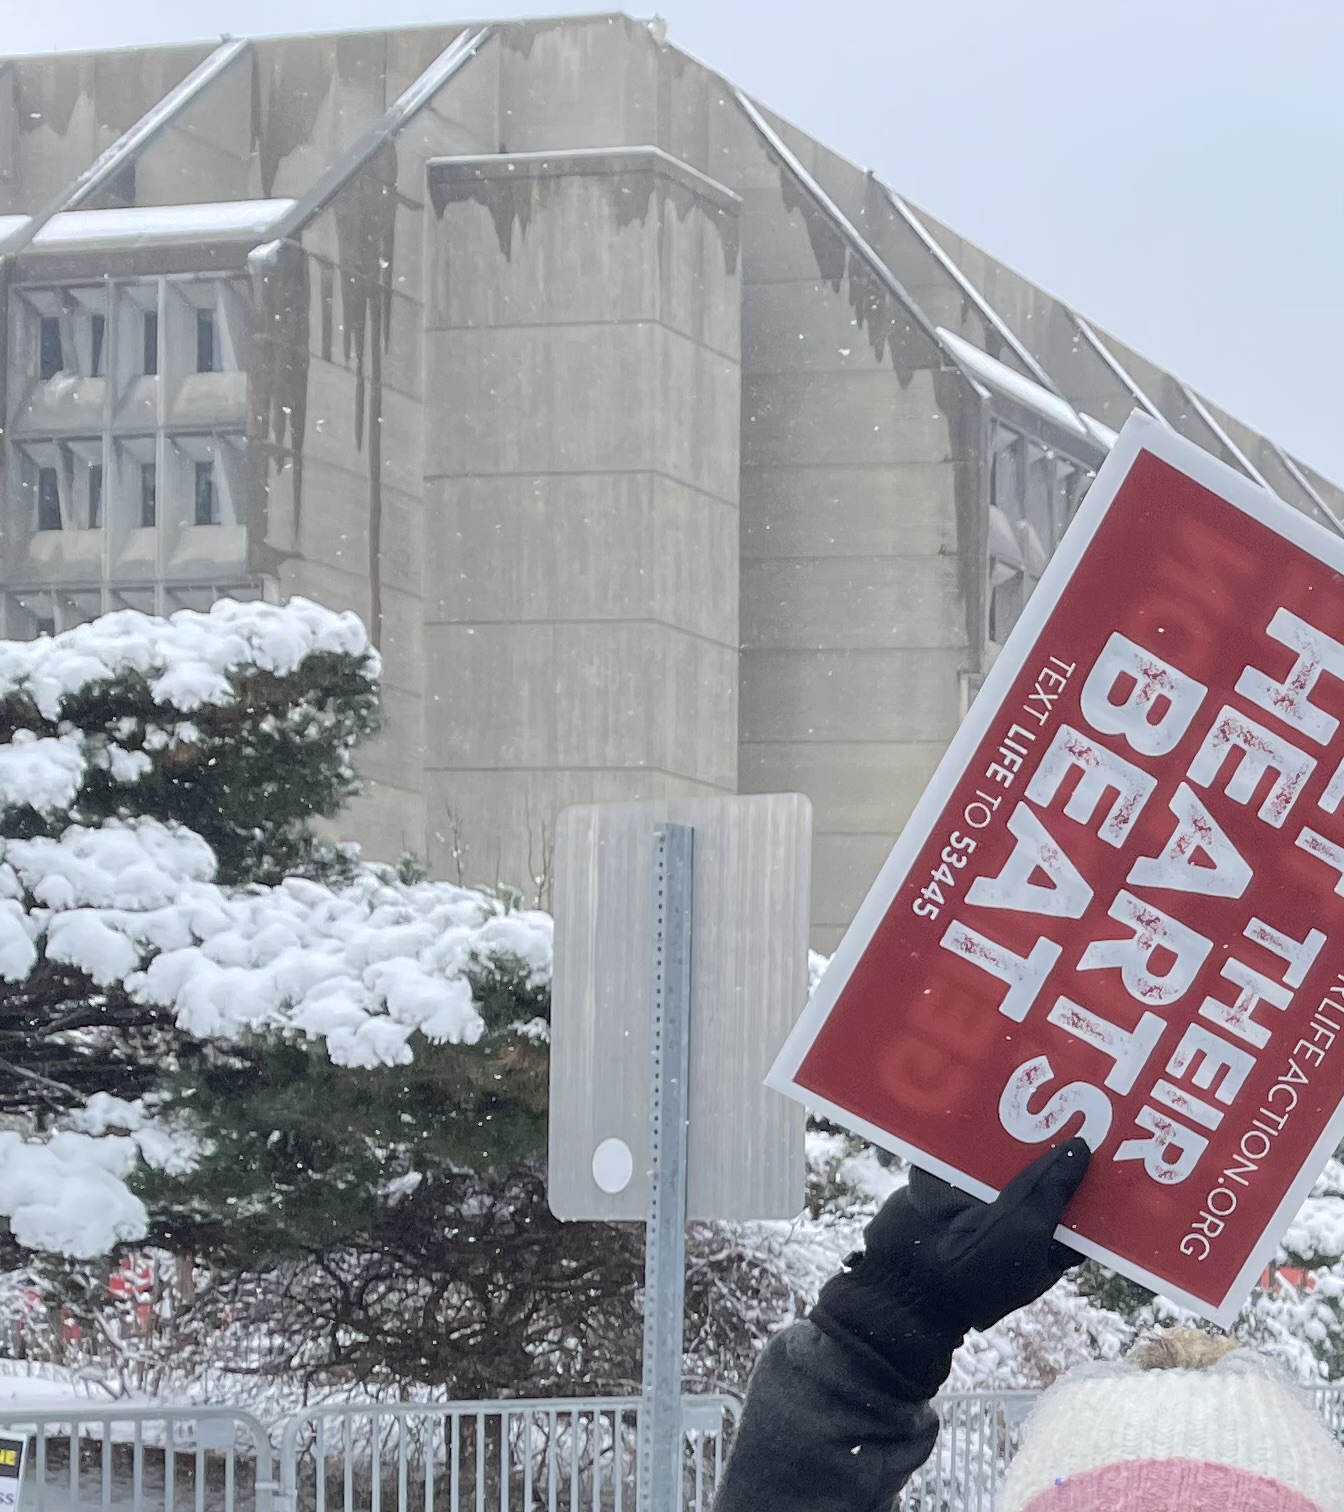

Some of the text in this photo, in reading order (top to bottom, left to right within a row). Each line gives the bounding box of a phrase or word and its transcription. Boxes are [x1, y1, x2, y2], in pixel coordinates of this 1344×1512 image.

[1023, 656, 1077, 726] TEXT
[985, 723, 1036, 789] LIFE
[939, 631, 1209, 1023] BEAT
[964, 789, 1002, 828] TO
[912, 830, 977, 921] 53445
[1108, 916, 1328, 1185] THEIR
